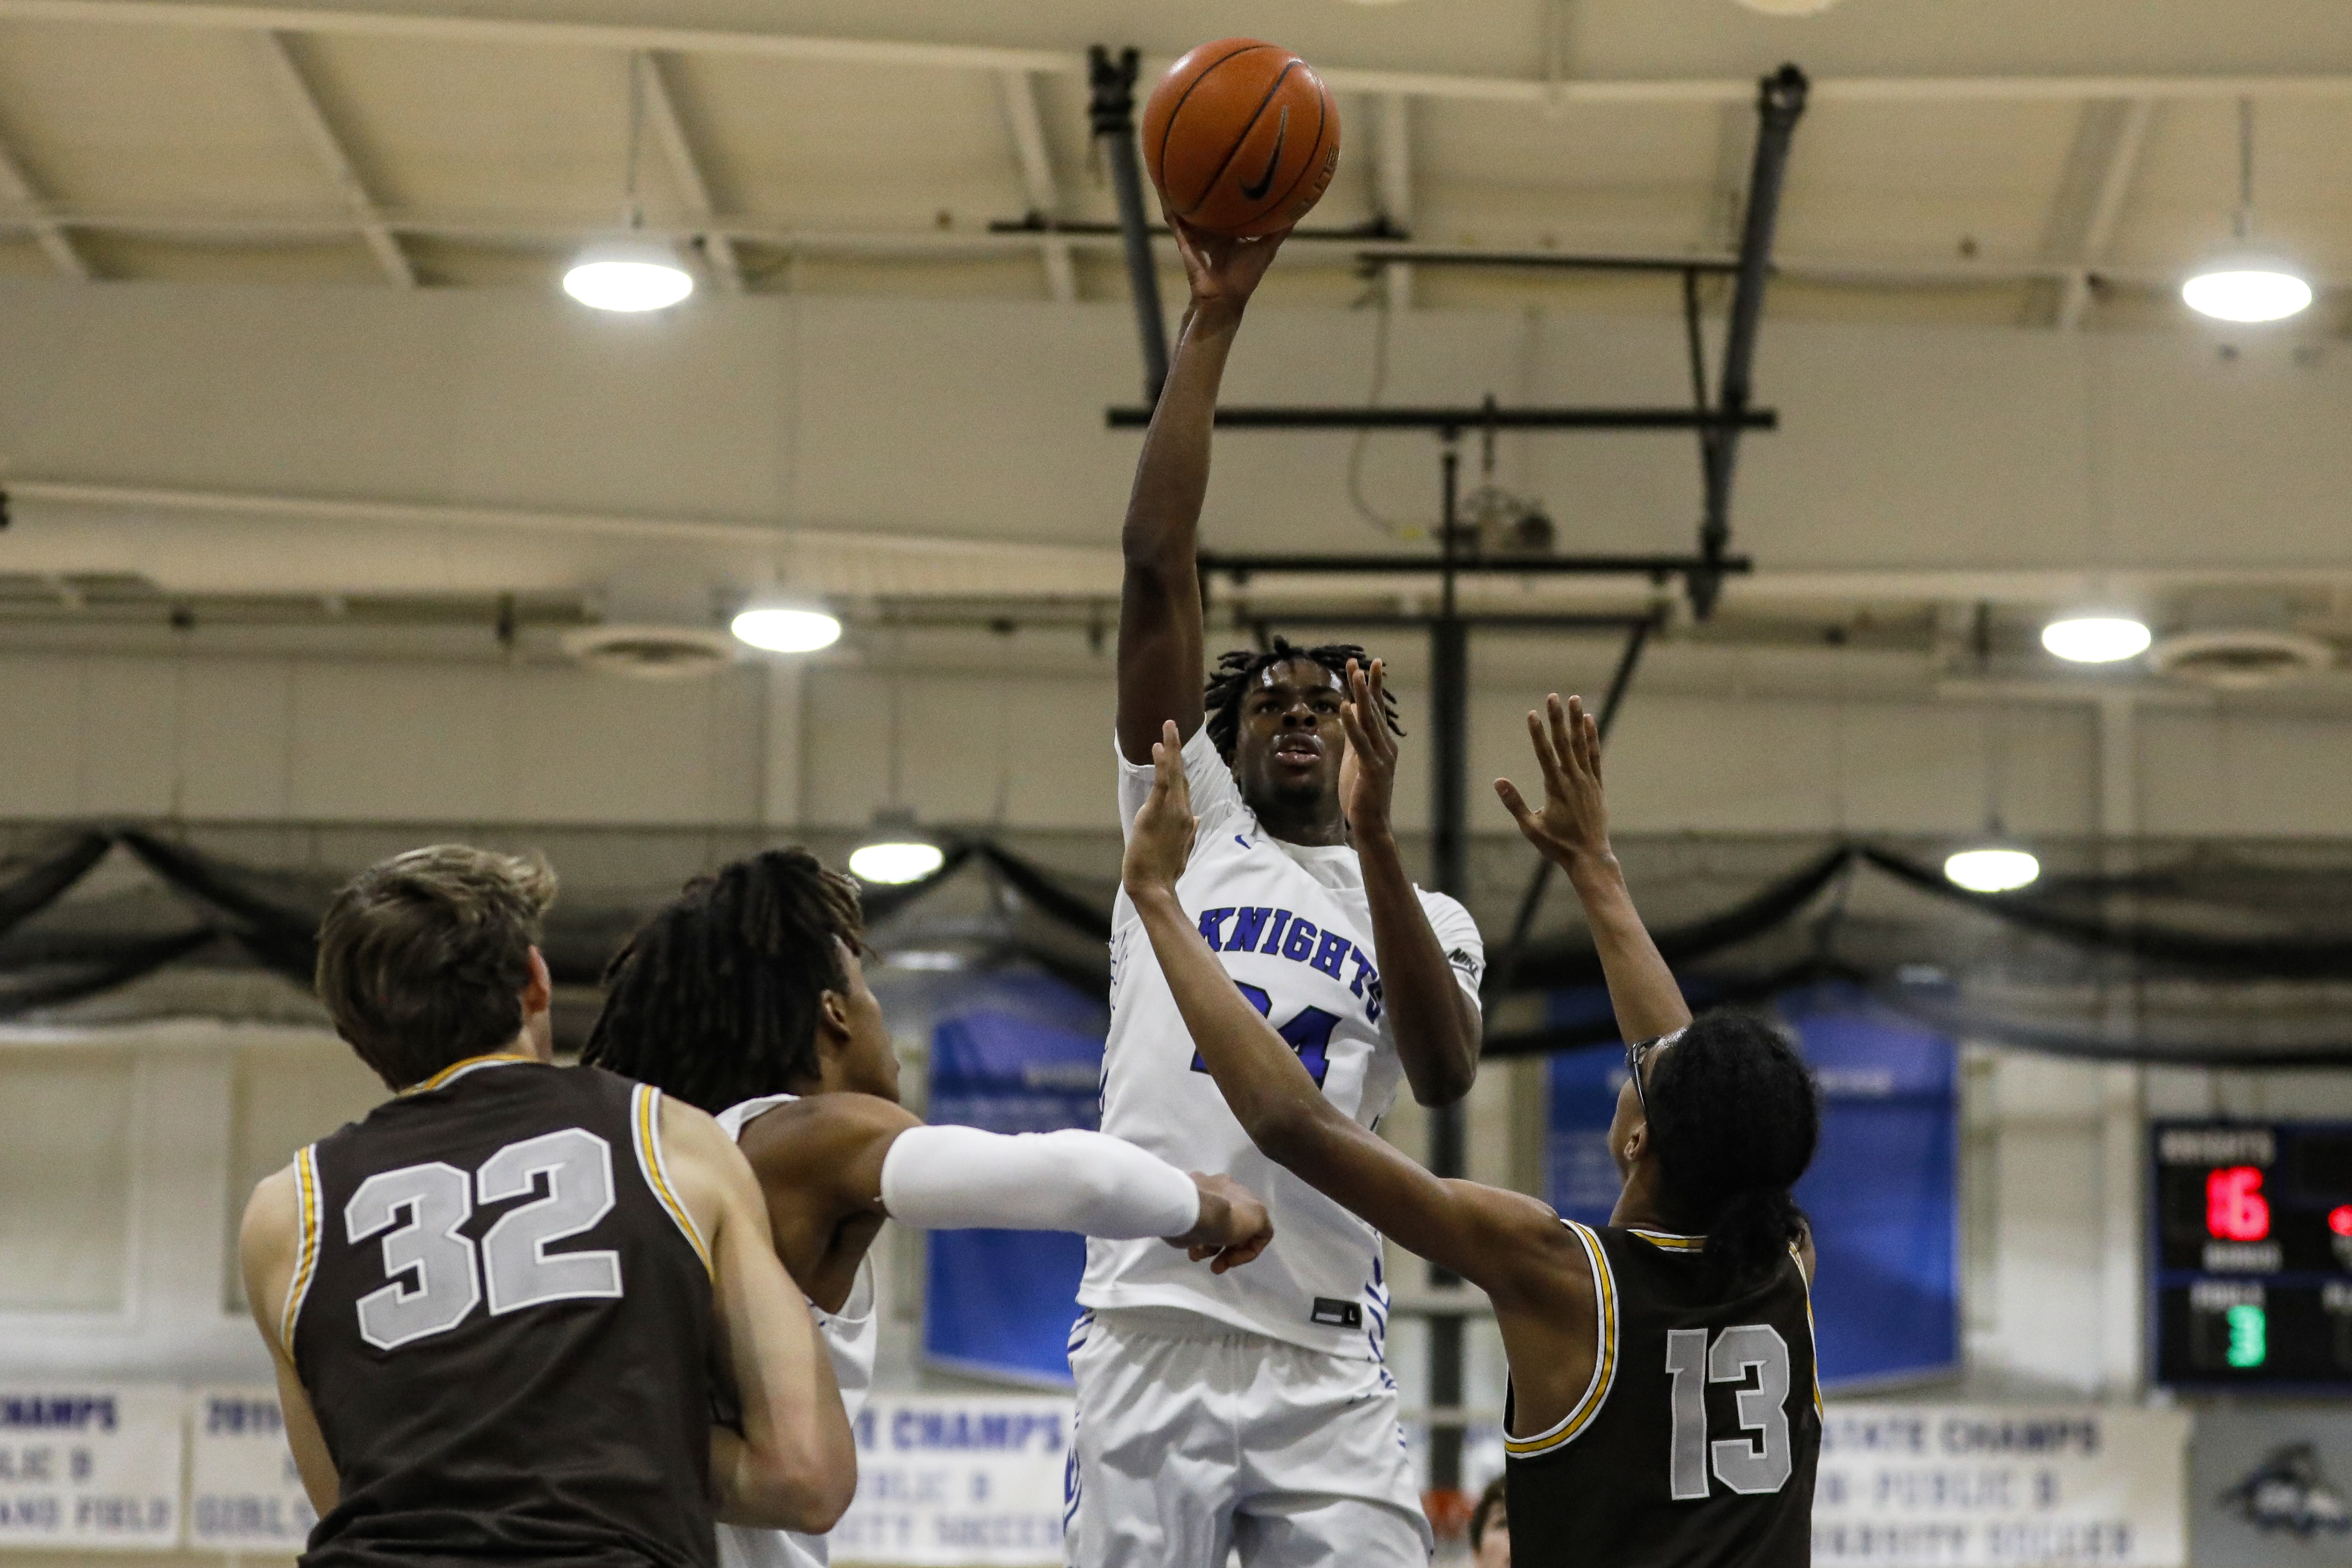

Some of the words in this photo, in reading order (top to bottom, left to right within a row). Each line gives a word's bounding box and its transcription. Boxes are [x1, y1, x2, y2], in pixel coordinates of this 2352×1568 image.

[2206, 1165, 2270, 1242] 16
[345, 1127, 623, 1351] 32
[2226, 1304, 2266, 1367] 3
[891, 1407, 1063, 1453] CHAMPS
[1665, 1324, 1792, 1500] 13
[1939, 1416, 2103, 1459] CHAMPS
